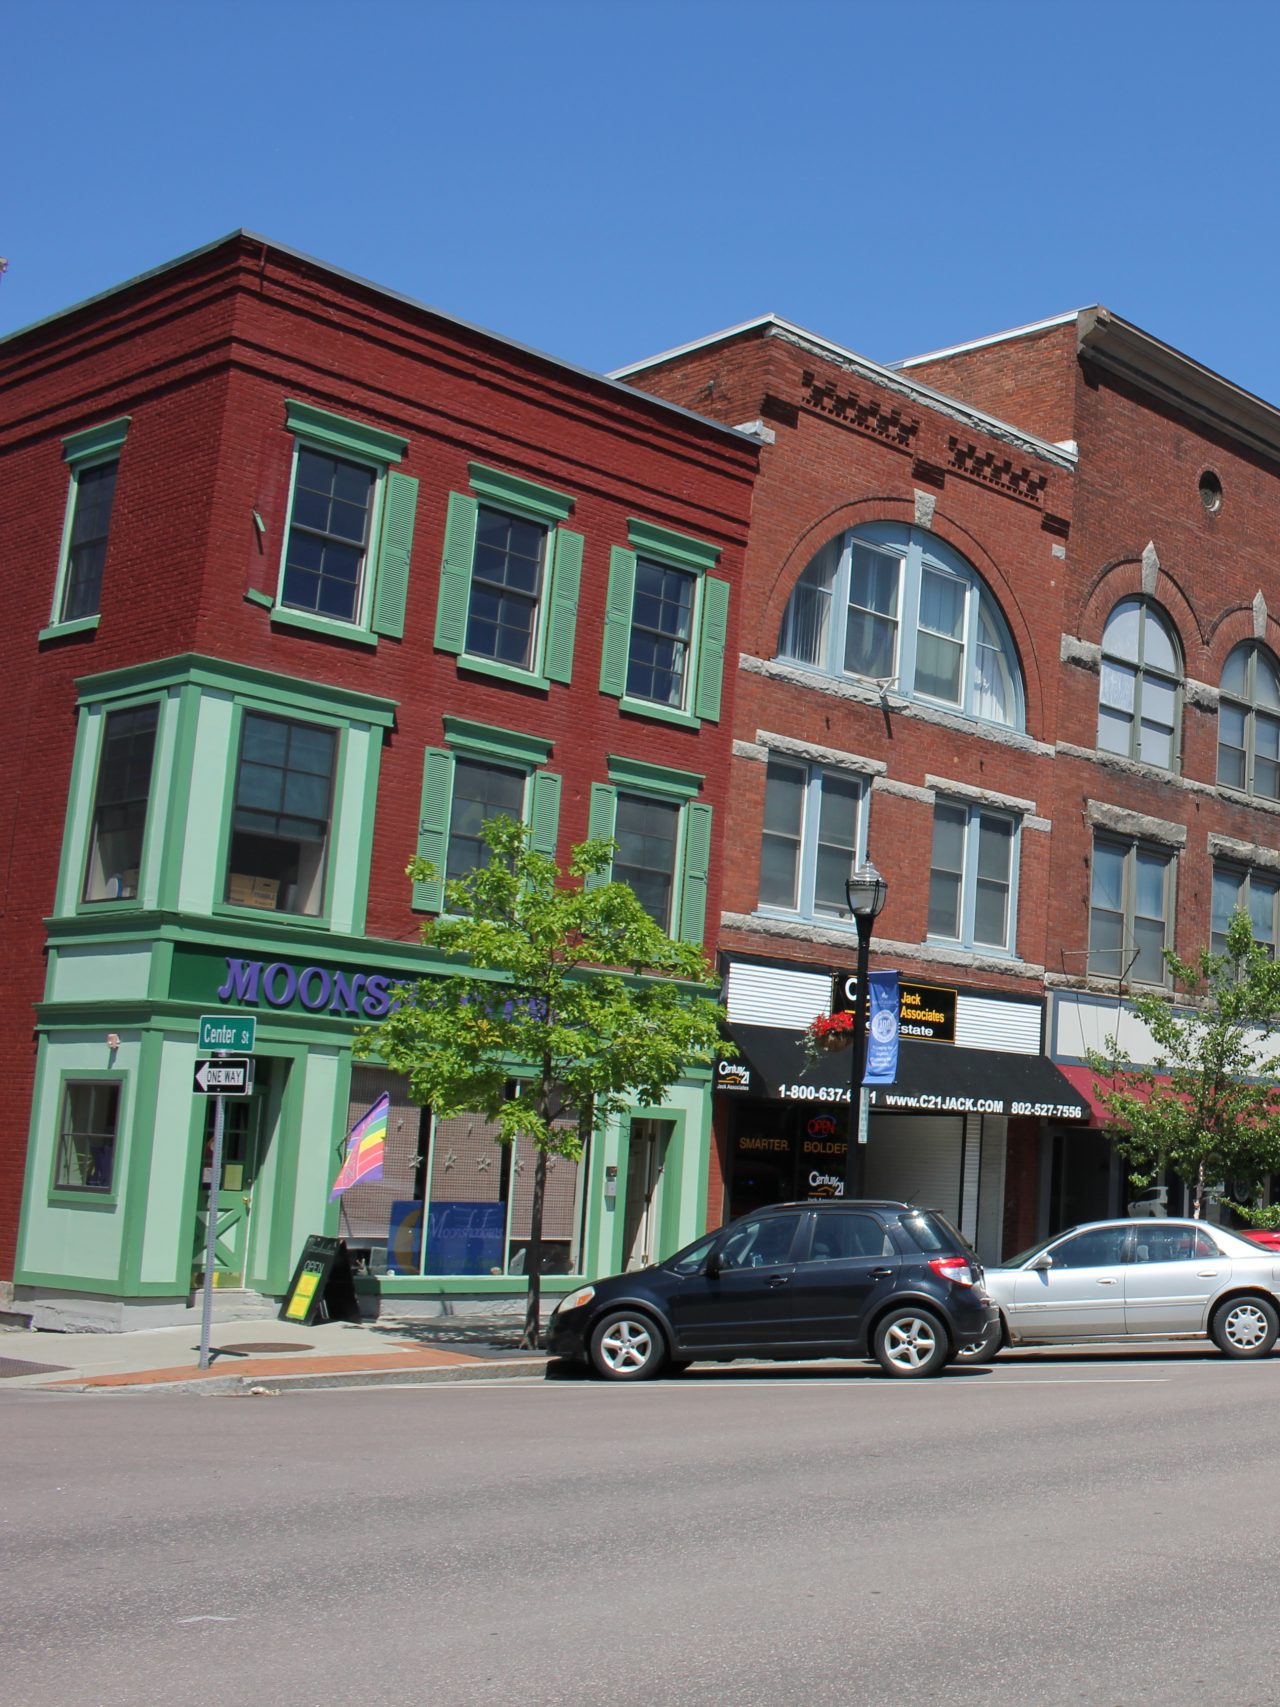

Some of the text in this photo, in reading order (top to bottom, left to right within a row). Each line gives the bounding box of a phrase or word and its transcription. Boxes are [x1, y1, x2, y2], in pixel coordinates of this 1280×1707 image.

[901, 992, 921, 1005] Jack
[900, 1005, 945, 1023] Associates
[204, 1023, 250, 1044] Center St
[898, 1021, 934, 1036] state
[207, 1070, 242, 1083] ONE WAY
[719, 1061, 750, 1084] Century 21
[1011, 1101, 1082, 1118] 802-527-7556
[807, 1119, 836, 1135] OPEN
[808, 1171, 845, 1196] Century 21
[303, 1260, 325, 1274] OPEN
